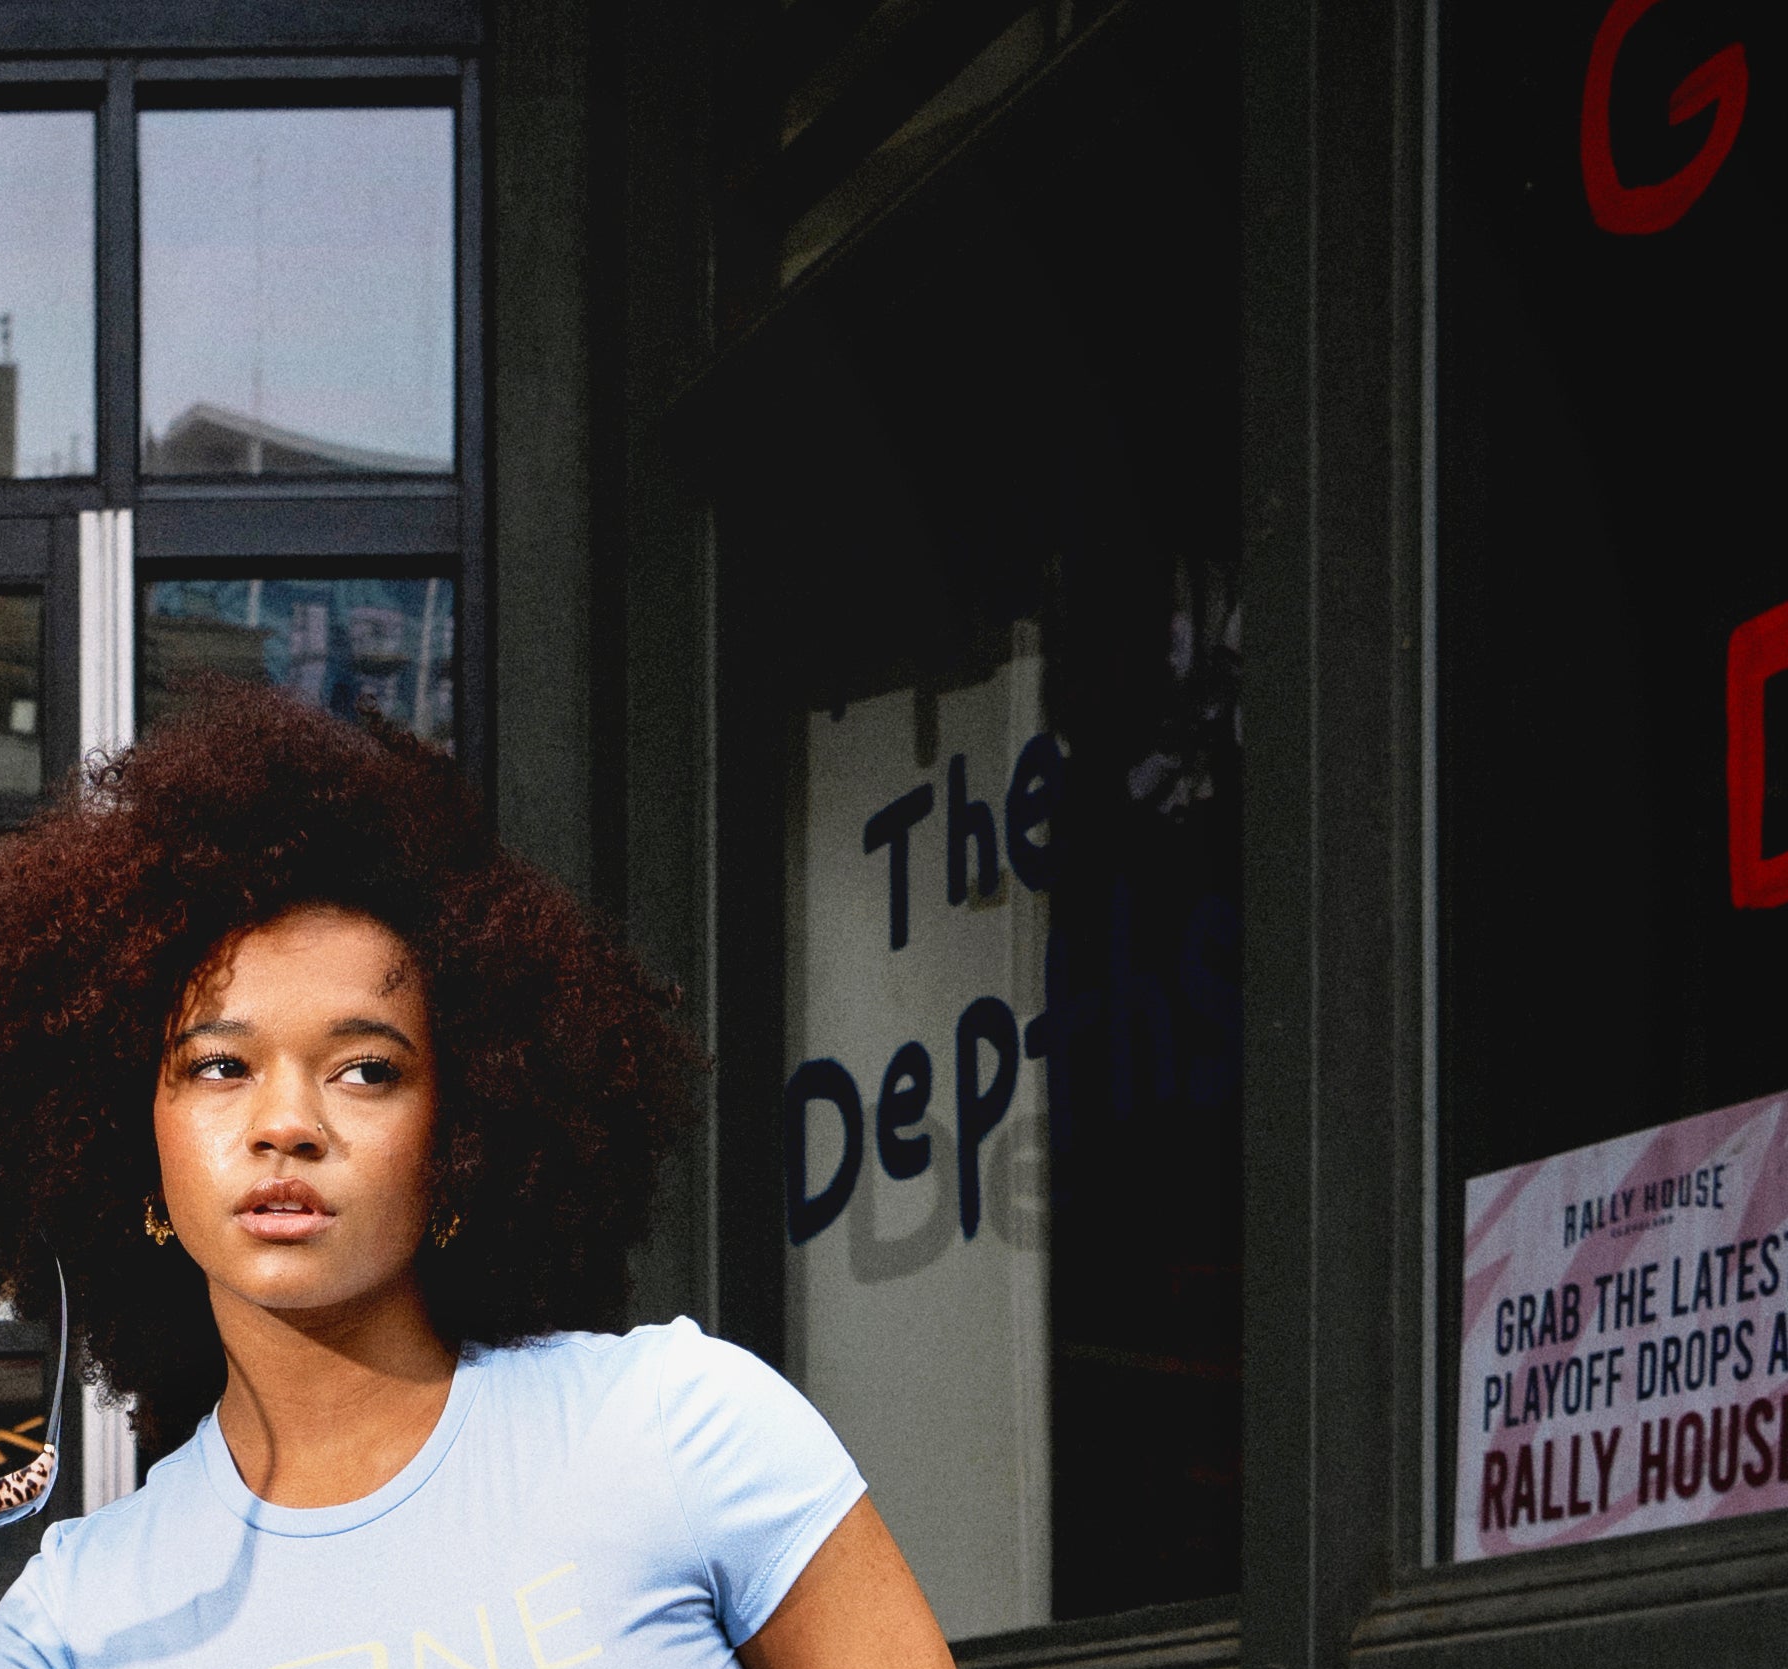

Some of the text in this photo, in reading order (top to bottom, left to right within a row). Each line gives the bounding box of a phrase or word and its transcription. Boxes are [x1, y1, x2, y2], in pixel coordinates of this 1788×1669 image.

[863, 732, 1062, 951] The
[1563, 1164, 1726, 1249] RALLY HOUSE
[1495, 1230, 1788, 1356] GRAB THE LATES
[1482, 1347, 1625, 1432] PLAYOFF
[1636, 1319, 1755, 1401] DROPS
[1480, 1426, 1622, 1533] RALLY
